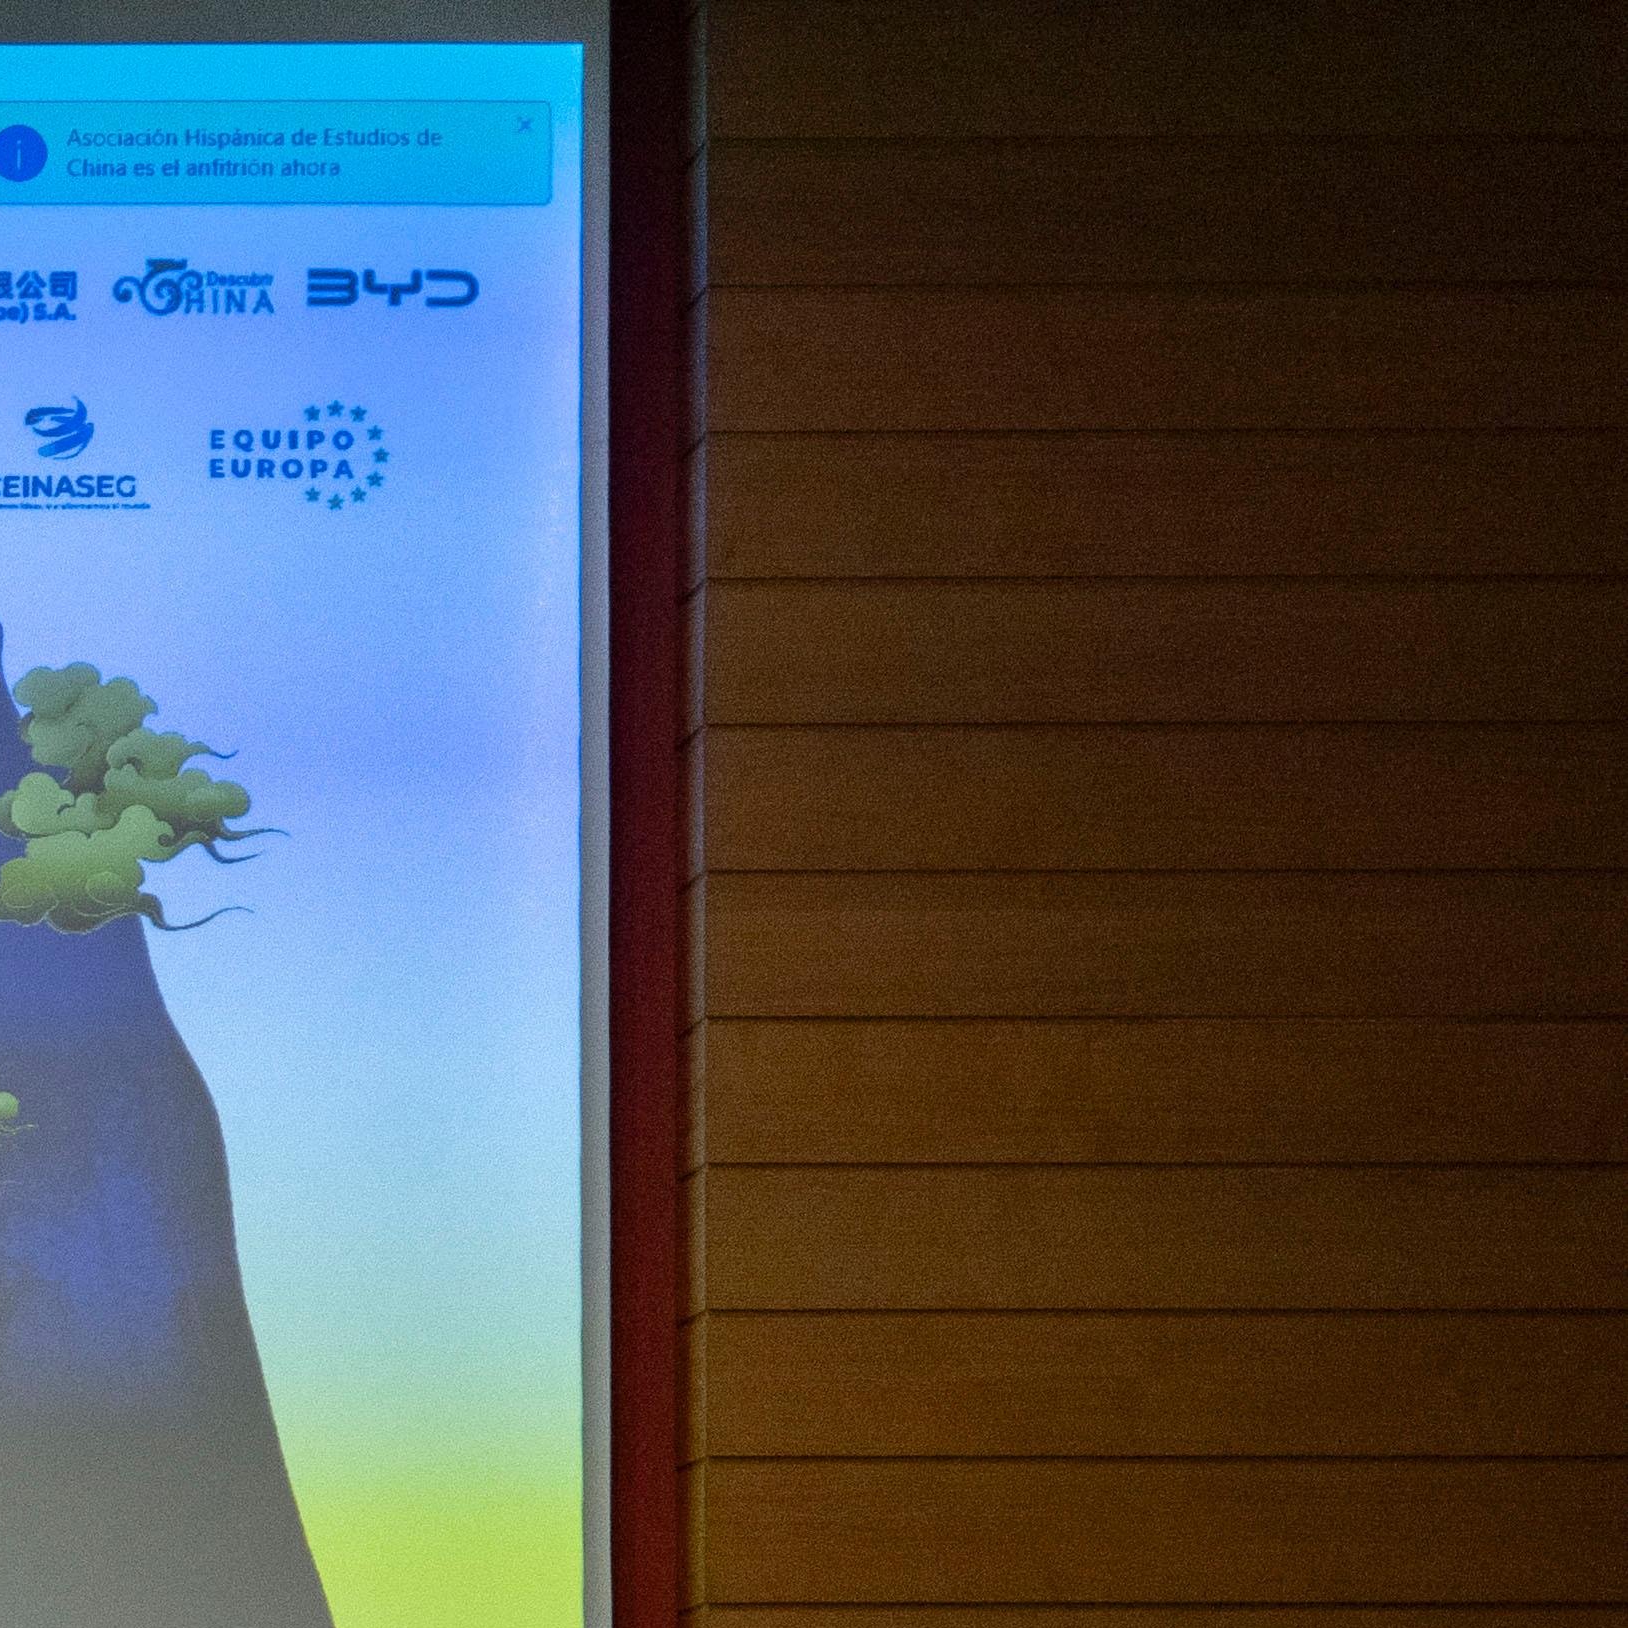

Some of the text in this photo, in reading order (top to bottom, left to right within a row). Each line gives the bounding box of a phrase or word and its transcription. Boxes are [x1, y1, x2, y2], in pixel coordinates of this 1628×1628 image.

[66, 128, 443, 151] Asociación Hispánica de Estudios de
[66, 158, 341, 178] China es el anfitrión ahora
[306, 267, 481, 309] BYD
[33, 303, 77, 322] S.A.
[209, 429, 355, 453] EQUIPO
[209, 458, 355, 480] EUROPA
